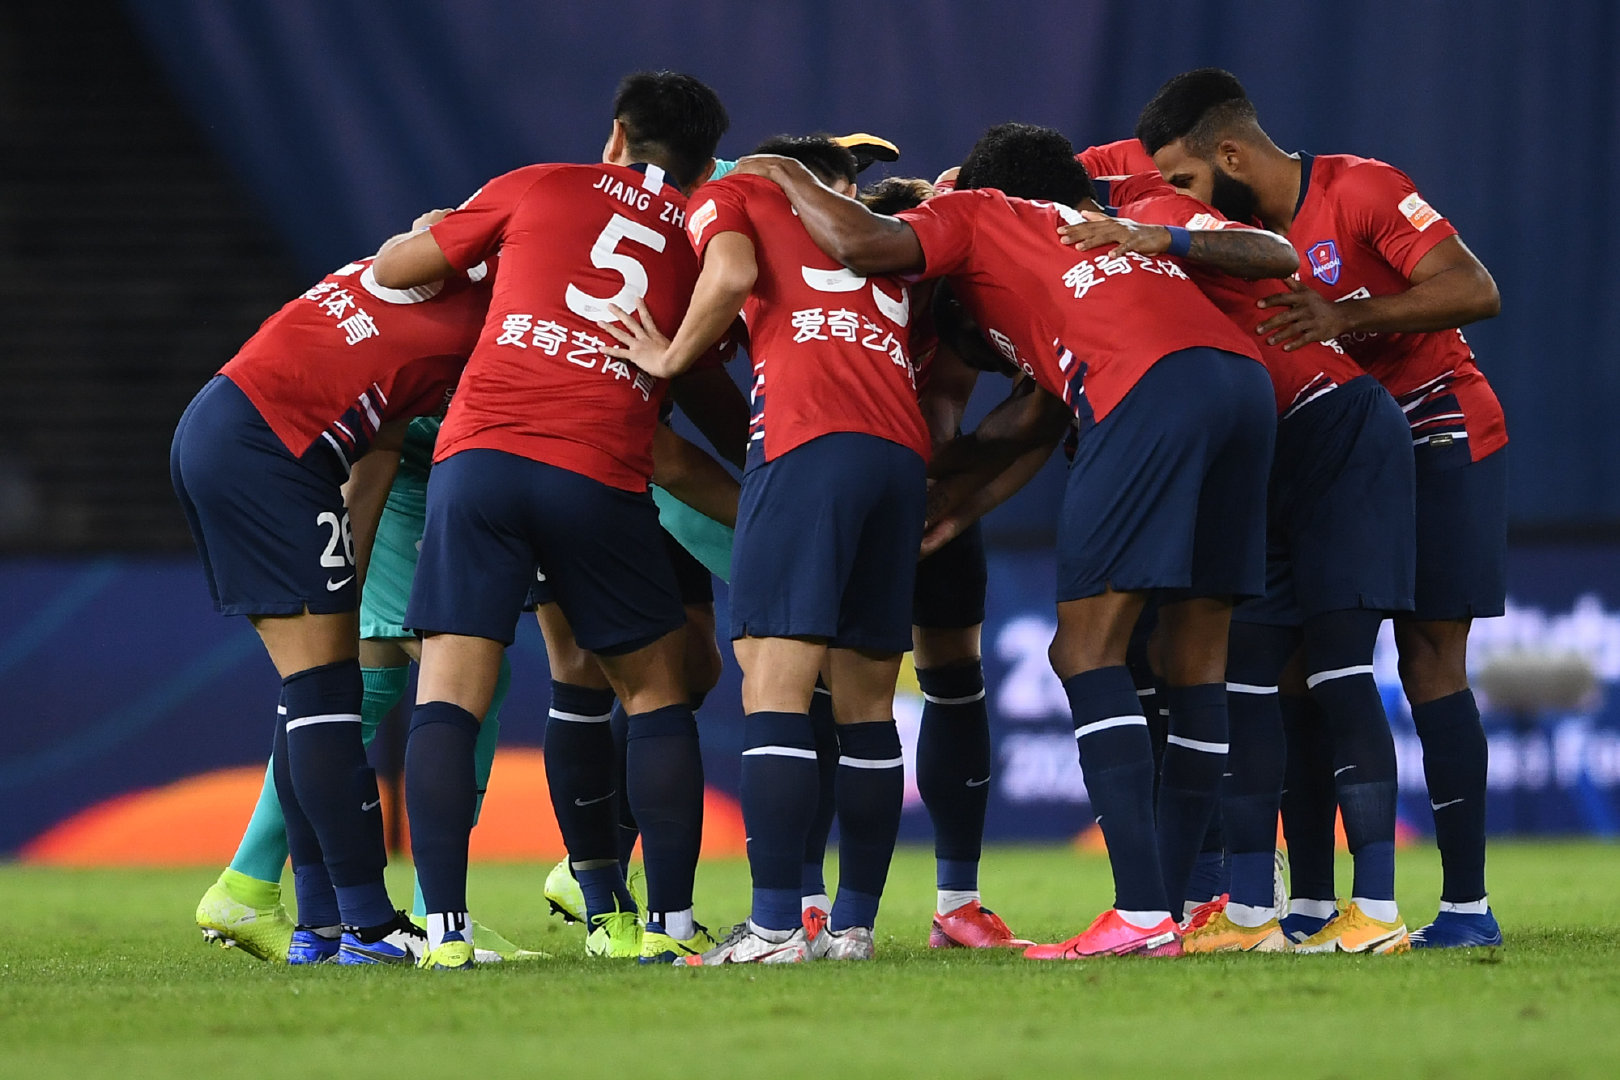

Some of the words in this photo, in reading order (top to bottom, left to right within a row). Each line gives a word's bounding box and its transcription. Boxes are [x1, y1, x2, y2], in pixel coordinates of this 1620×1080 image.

[593, 174, 651, 211] JIANG
[659, 201, 688, 231] ZH
[565, 212, 666, 323] 5
